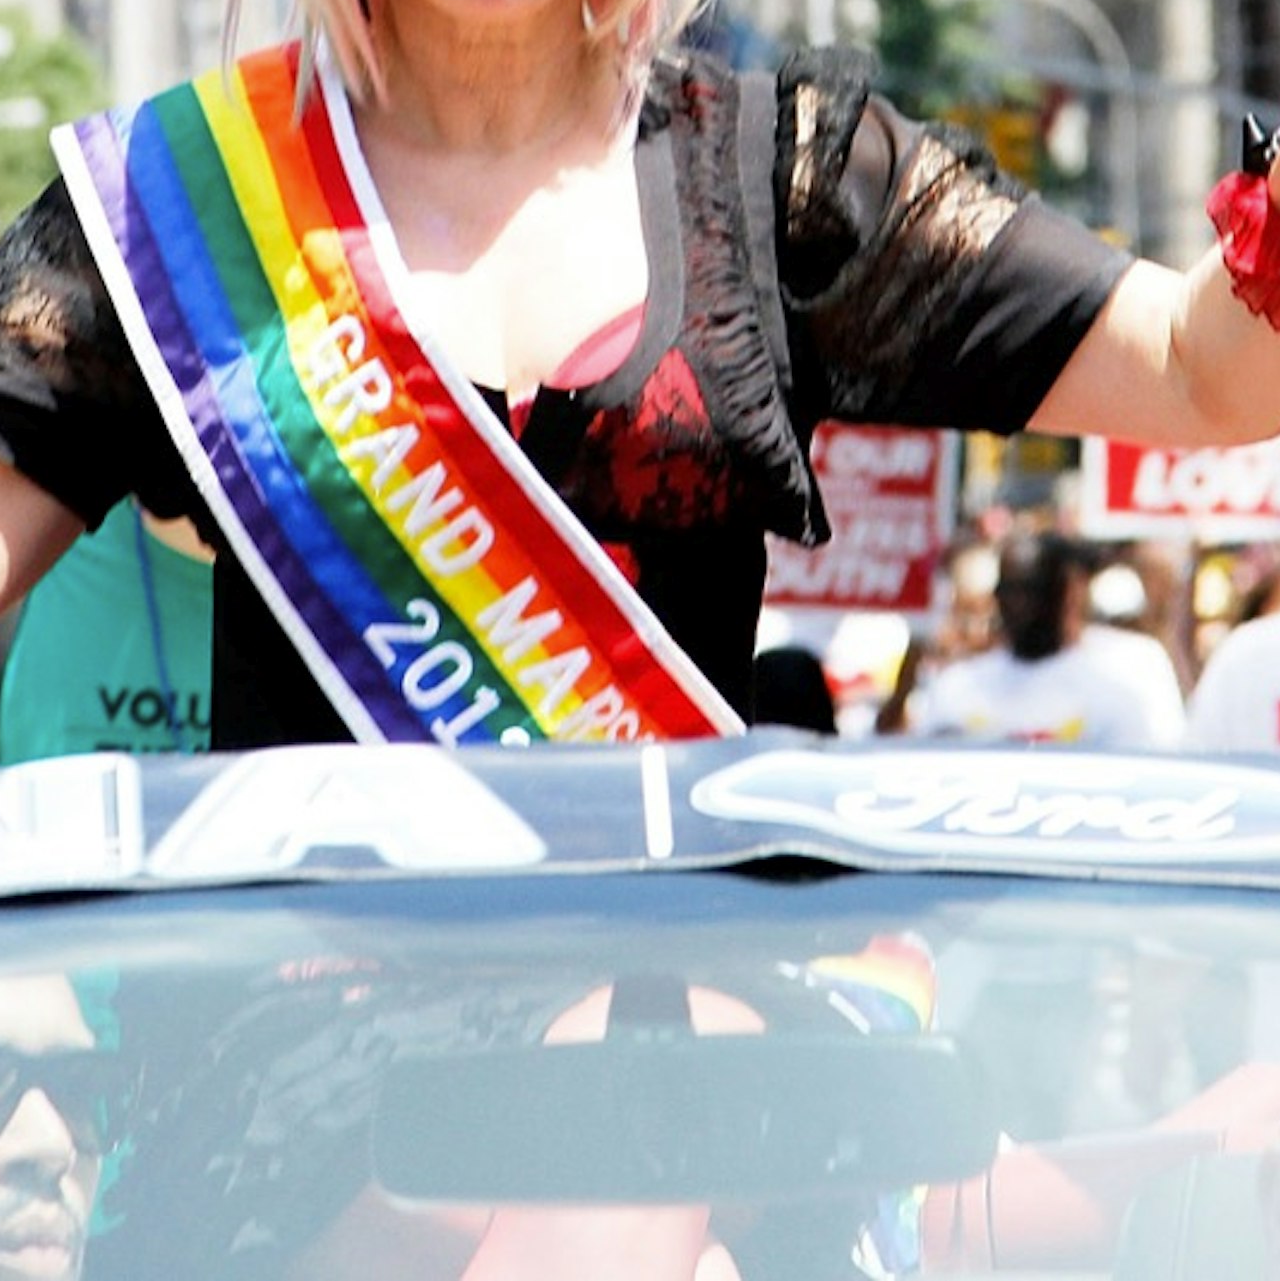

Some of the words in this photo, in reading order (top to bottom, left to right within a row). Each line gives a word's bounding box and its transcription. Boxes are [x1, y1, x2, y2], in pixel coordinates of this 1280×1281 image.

[308, 314, 496, 577] GRAND
[362, 598, 531, 750] 201
[834, 763, 1237, 842] Ford
